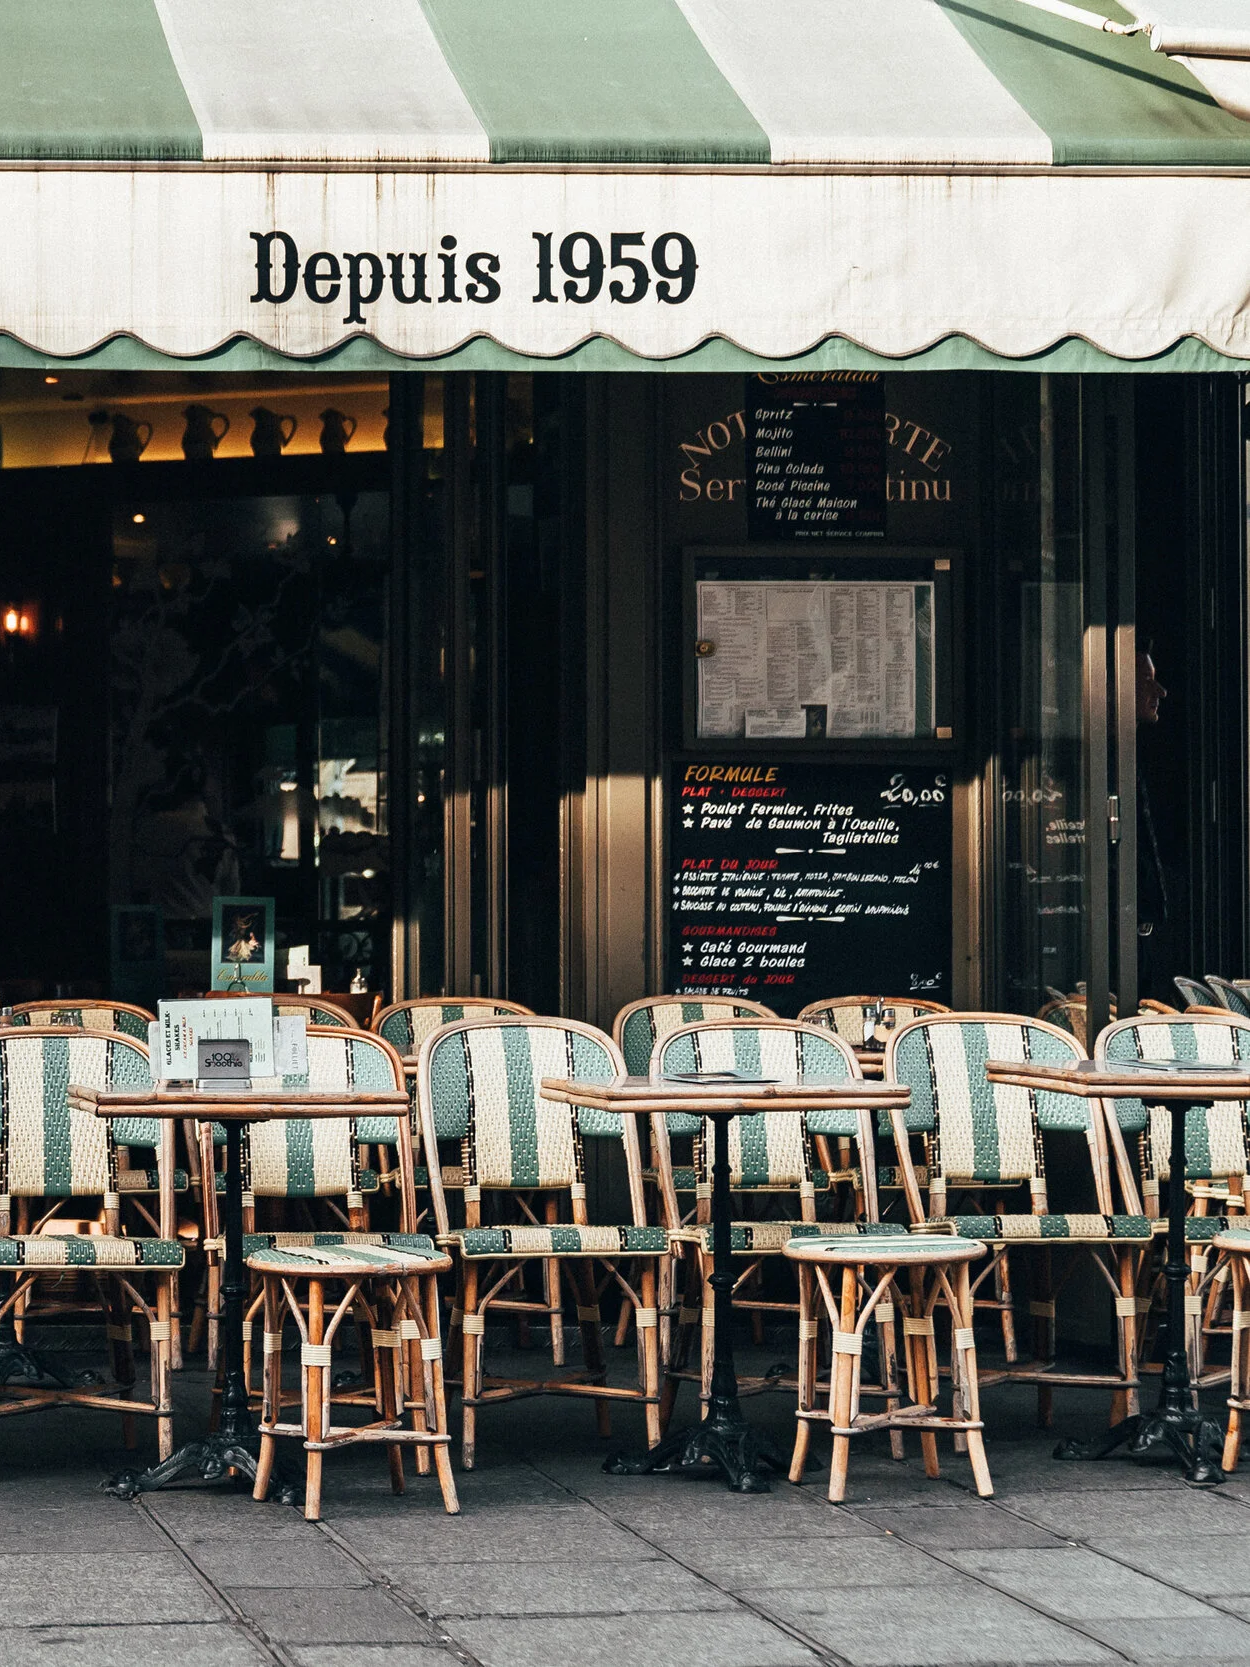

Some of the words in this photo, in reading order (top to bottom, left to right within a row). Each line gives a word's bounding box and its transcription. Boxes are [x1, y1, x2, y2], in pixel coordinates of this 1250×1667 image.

[250, 230, 501, 324] Depuis
[532, 230, 699, 305] 1959
[755, 408, 793, 421] Spritz
[755, 427, 793, 441] Mojito
[755, 446, 792, 457] Bellini
[755, 463, 780, 474] Pina
[786, 462, 824, 475] Colada
[755, 479, 787, 492] Rosé
[790, 480, 830, 492] Piscine
[755, 496, 777, 508] Thé
[781, 496, 814, 509] Glacé
[817, 498, 857, 509] Maison
[775, 508, 782, 520] à
[787, 509, 798, 520] la
[803, 511, 839, 521] cerise
[684, 765, 779, 782] FORMULE
[681, 786, 713, 797] PLAT
[731, 787, 786, 798] DESSERT
[700, 802, 746, 815] Poulet
[813, 804, 854, 816] Frites
[700, 816, 732, 829] Pavé
[745, 817, 762, 829] de
[768, 817, 821, 830] Saumon
[828, 816, 836, 830] à
[823, 832, 900, 846] Tagliatelles
[681, 859, 714, 870] PLAT
[720, 859, 739, 870] DU
[745, 859, 779, 870] JOUR
[682, 870, 719, 881] ASSIETTE
[721, 870, 766, 882] ITALIENNE
[681, 925, 778, 936] GOURMANDISES
[700, 939, 732, 953] Café
[737, 941, 807, 954] Gourmand
[700, 955, 737, 967] Glace
[742, 956, 754, 967] 2
[759, 955, 806, 968] boules
[681, 974, 736, 984] DESSERT
[742, 974, 758, 984] du
[764, 974, 795, 985] JOUR
[165, 1030, 172, 1038] ET
